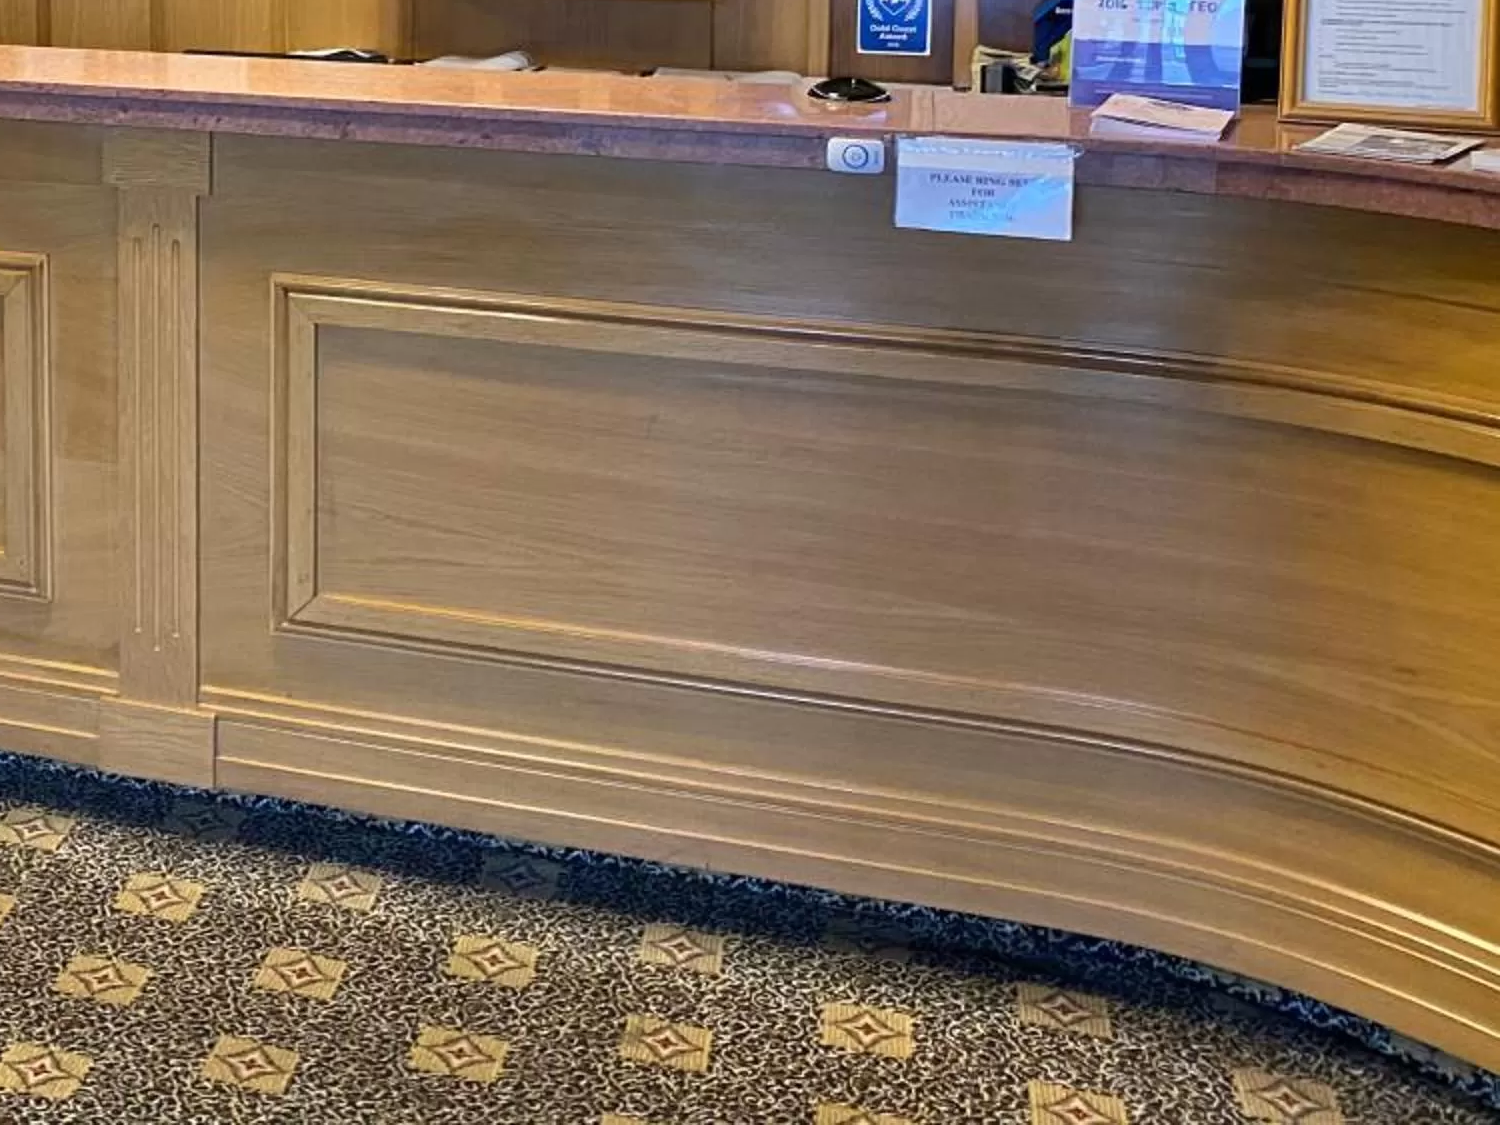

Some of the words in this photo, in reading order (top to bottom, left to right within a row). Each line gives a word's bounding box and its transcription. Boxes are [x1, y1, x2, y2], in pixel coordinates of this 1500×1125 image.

[929, 173, 972, 184] PLEASE
[975, 176, 1006, 186] RING
[971, 187, 995, 197] FOR
